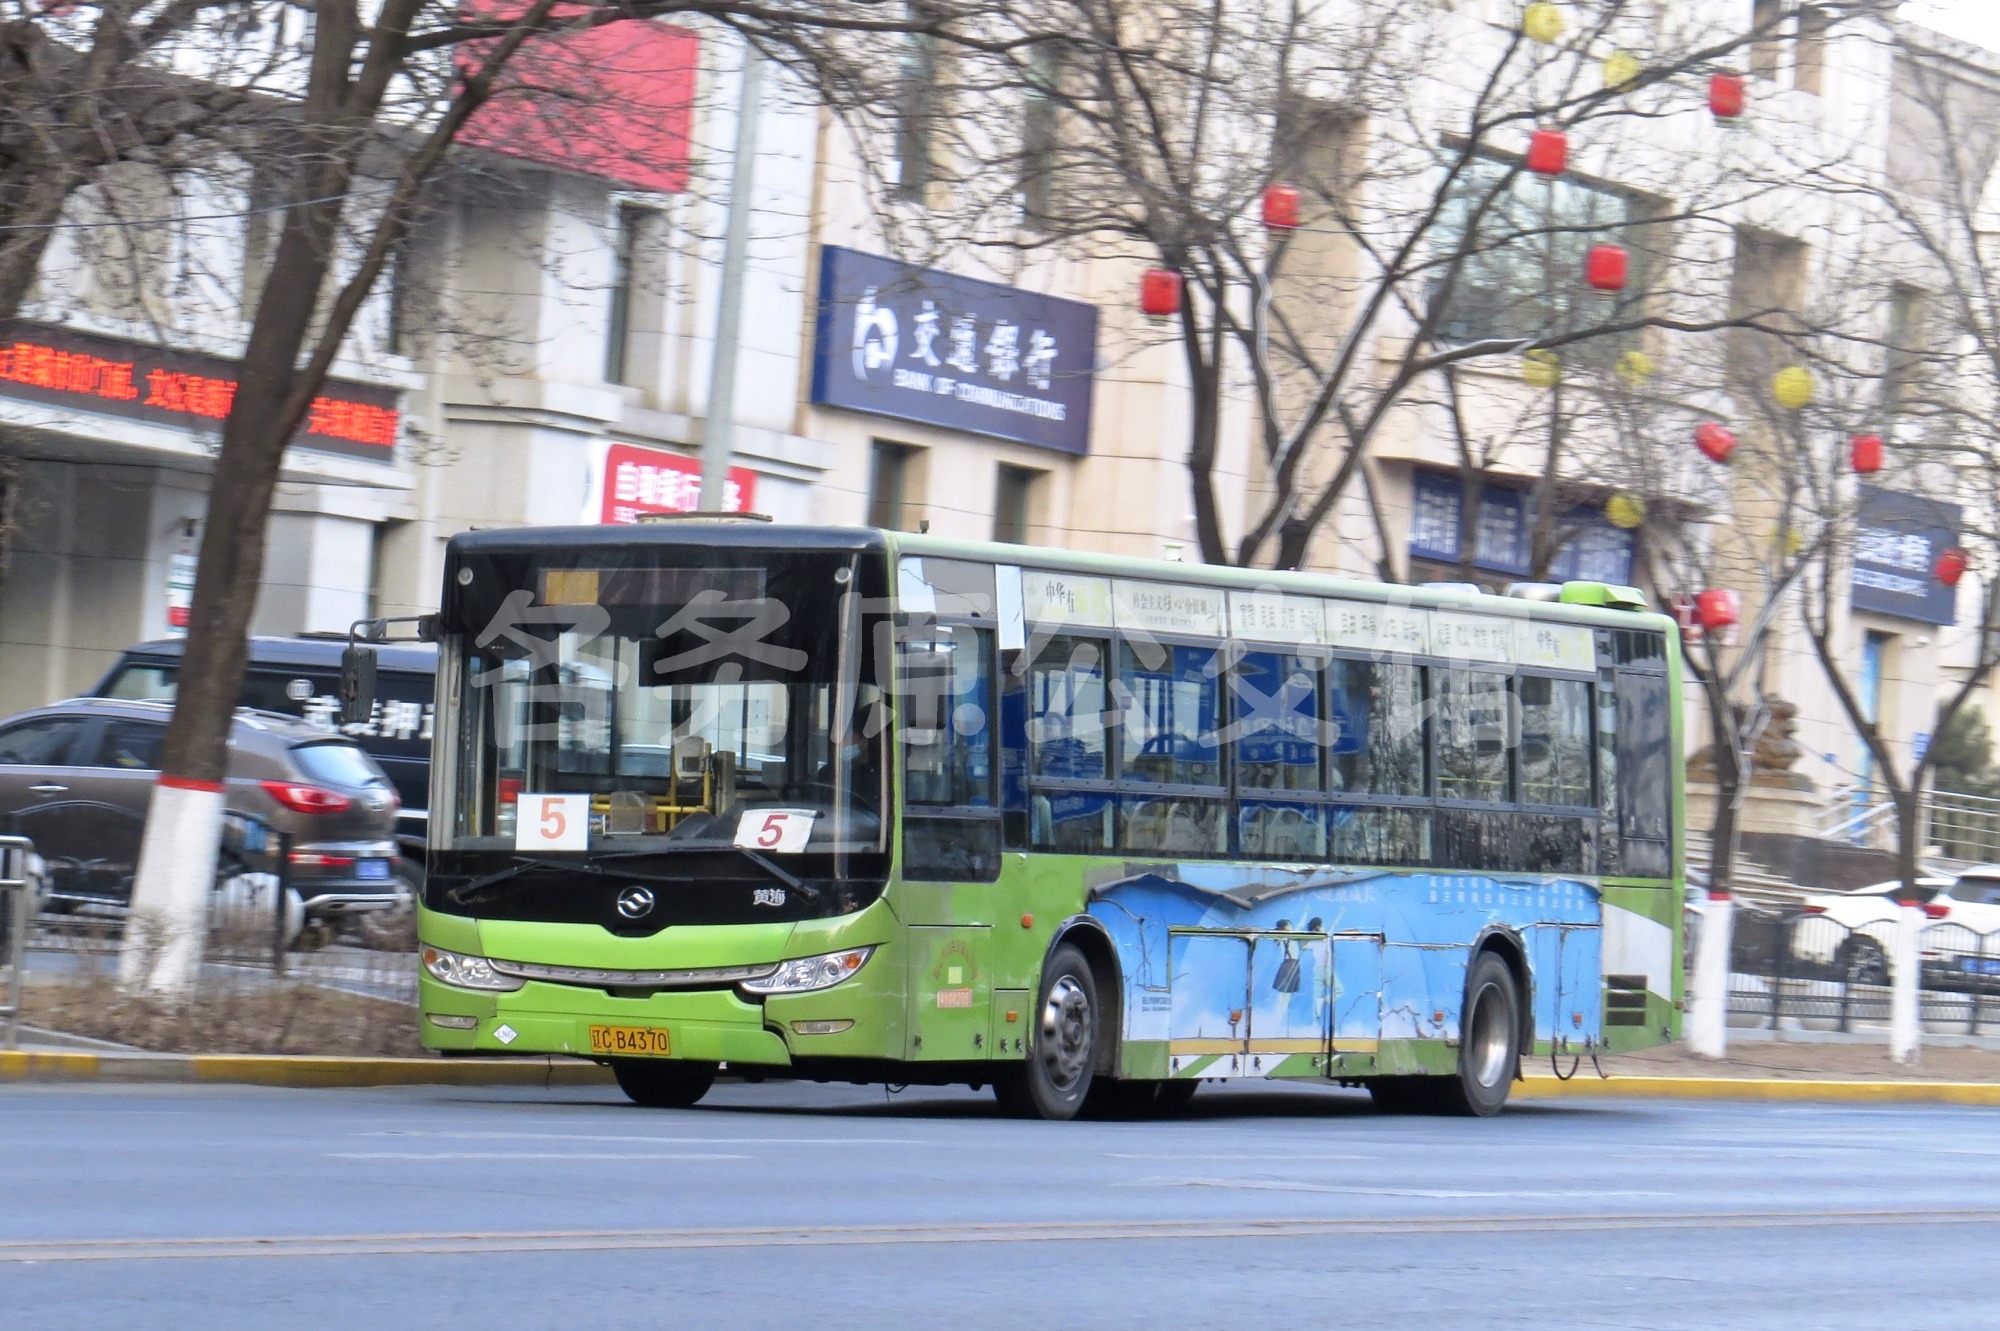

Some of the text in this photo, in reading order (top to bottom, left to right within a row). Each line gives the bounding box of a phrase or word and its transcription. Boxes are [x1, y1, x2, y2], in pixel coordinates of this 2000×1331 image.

[539, 797, 567, 840] 5
[757, 813, 789, 847] 5
[753, 888, 786, 907] 黄海
